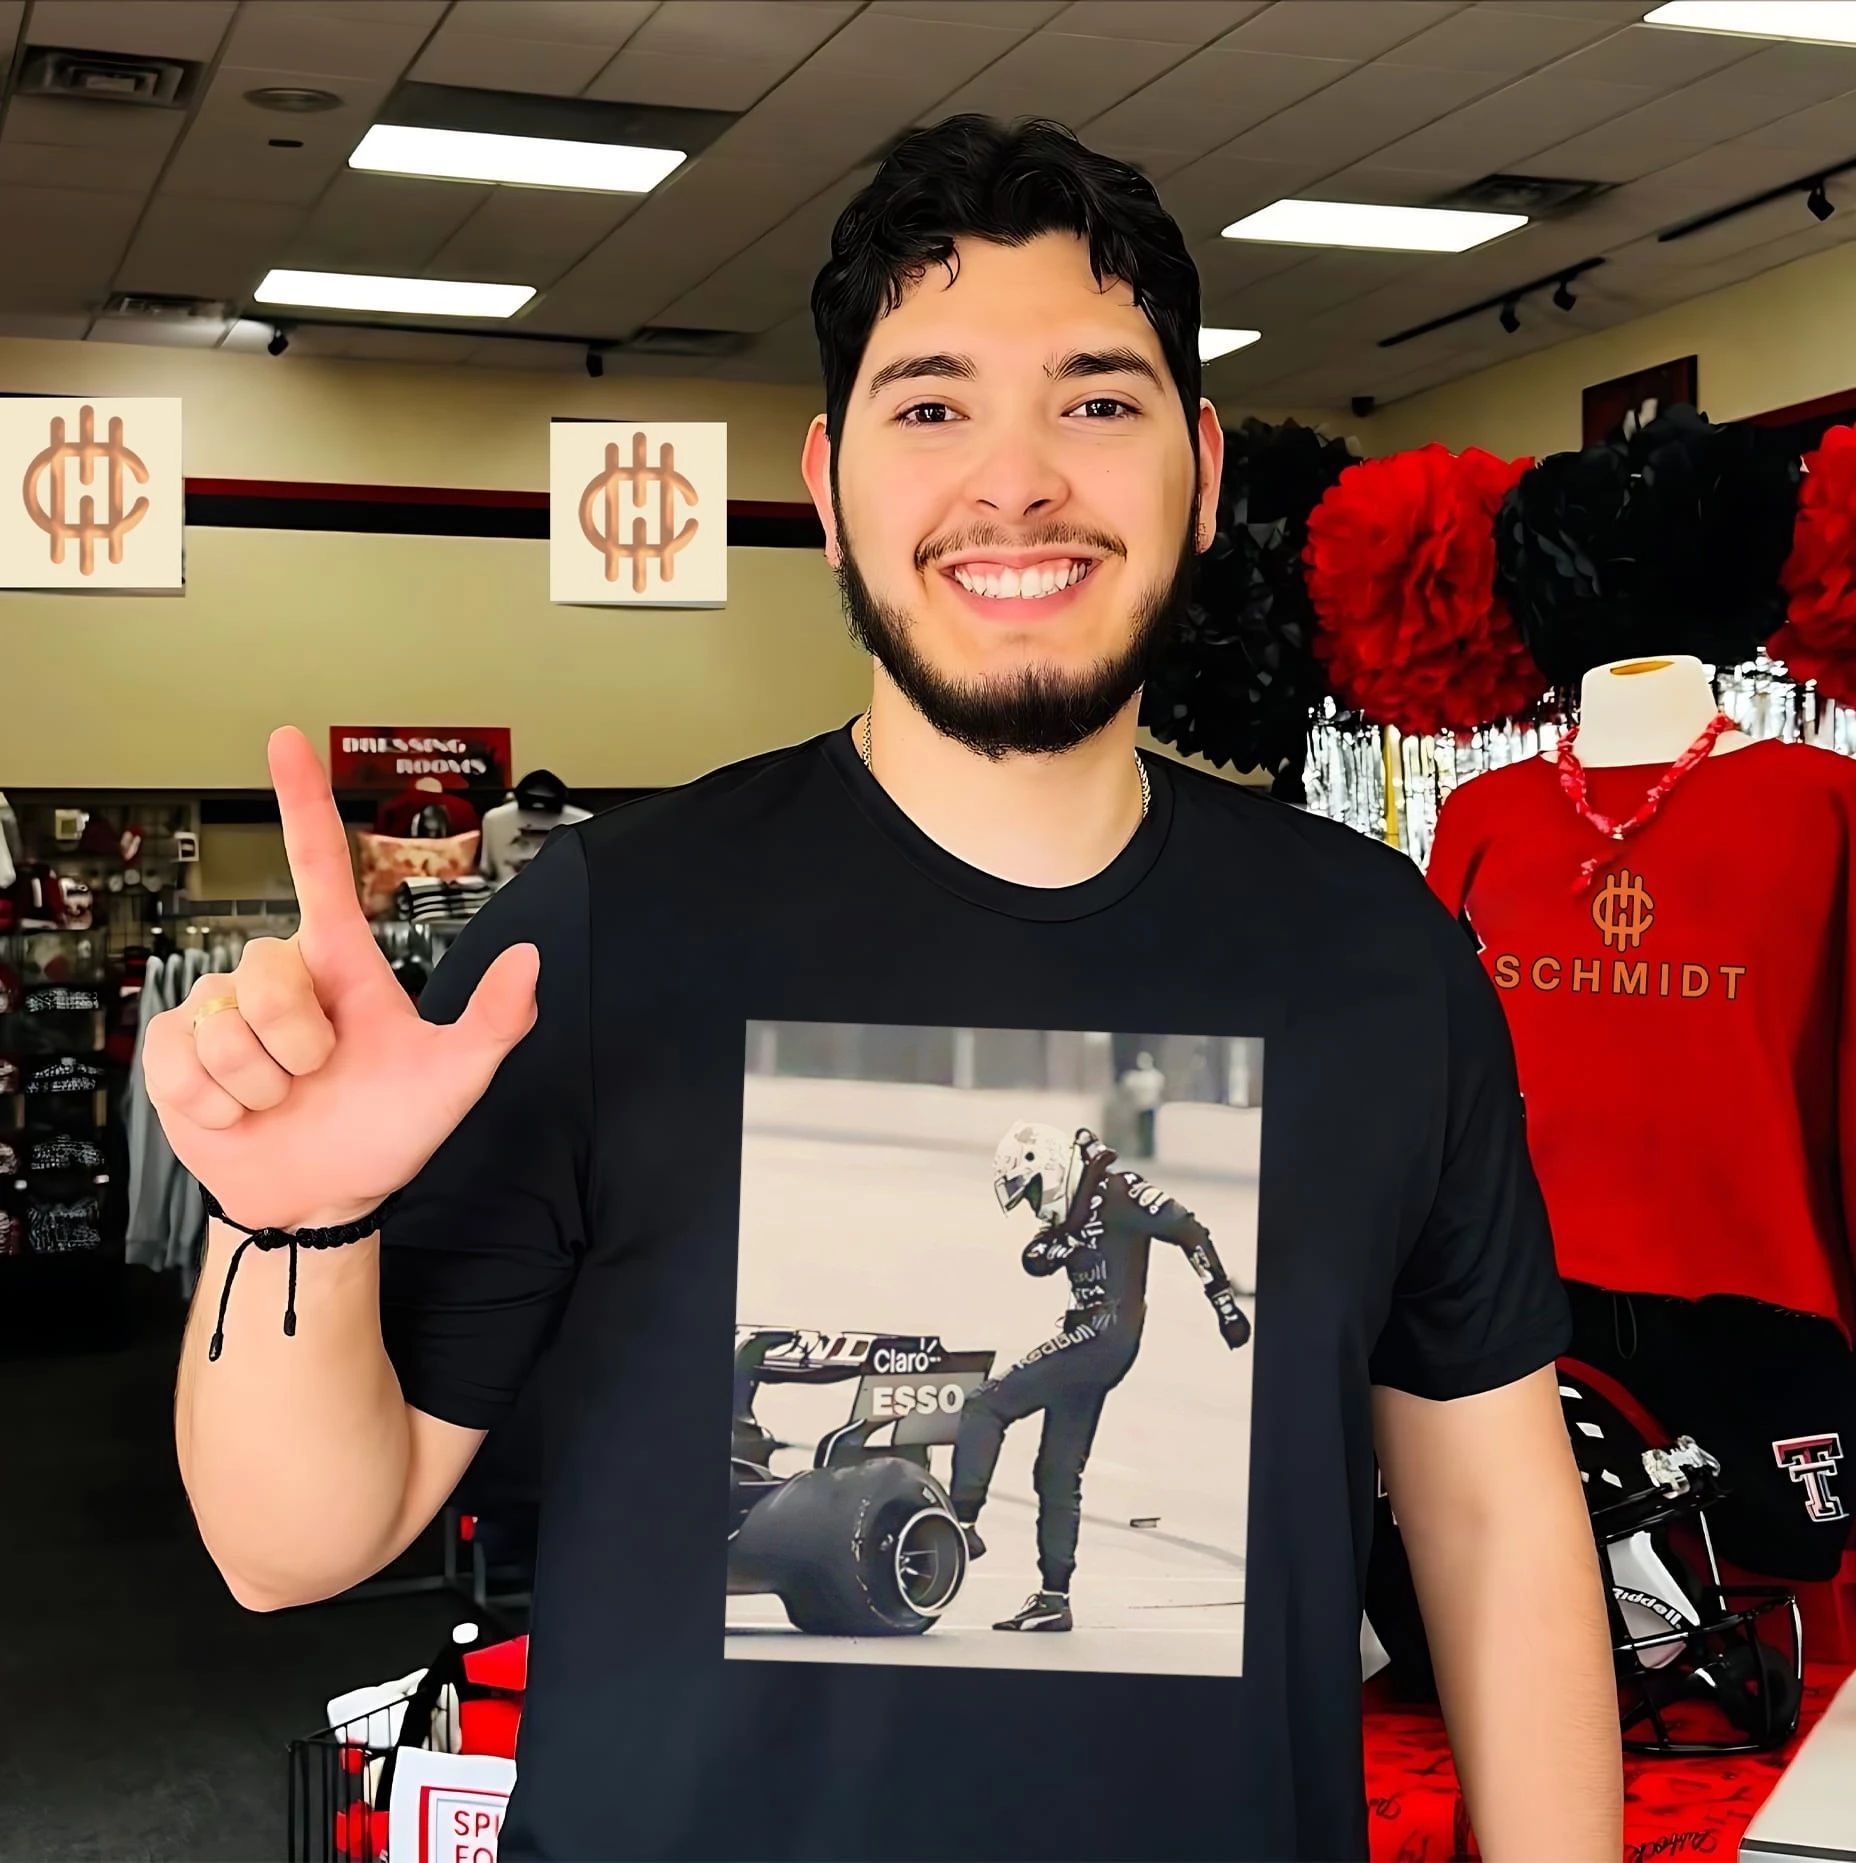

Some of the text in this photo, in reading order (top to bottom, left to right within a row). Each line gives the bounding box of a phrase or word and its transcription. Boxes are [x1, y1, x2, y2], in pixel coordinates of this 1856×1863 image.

[1494, 954, 1748, 1001] SCHMIDT
[873, 1347, 929, 1374] Claro
[871, 1383, 965, 1417] ESSO
